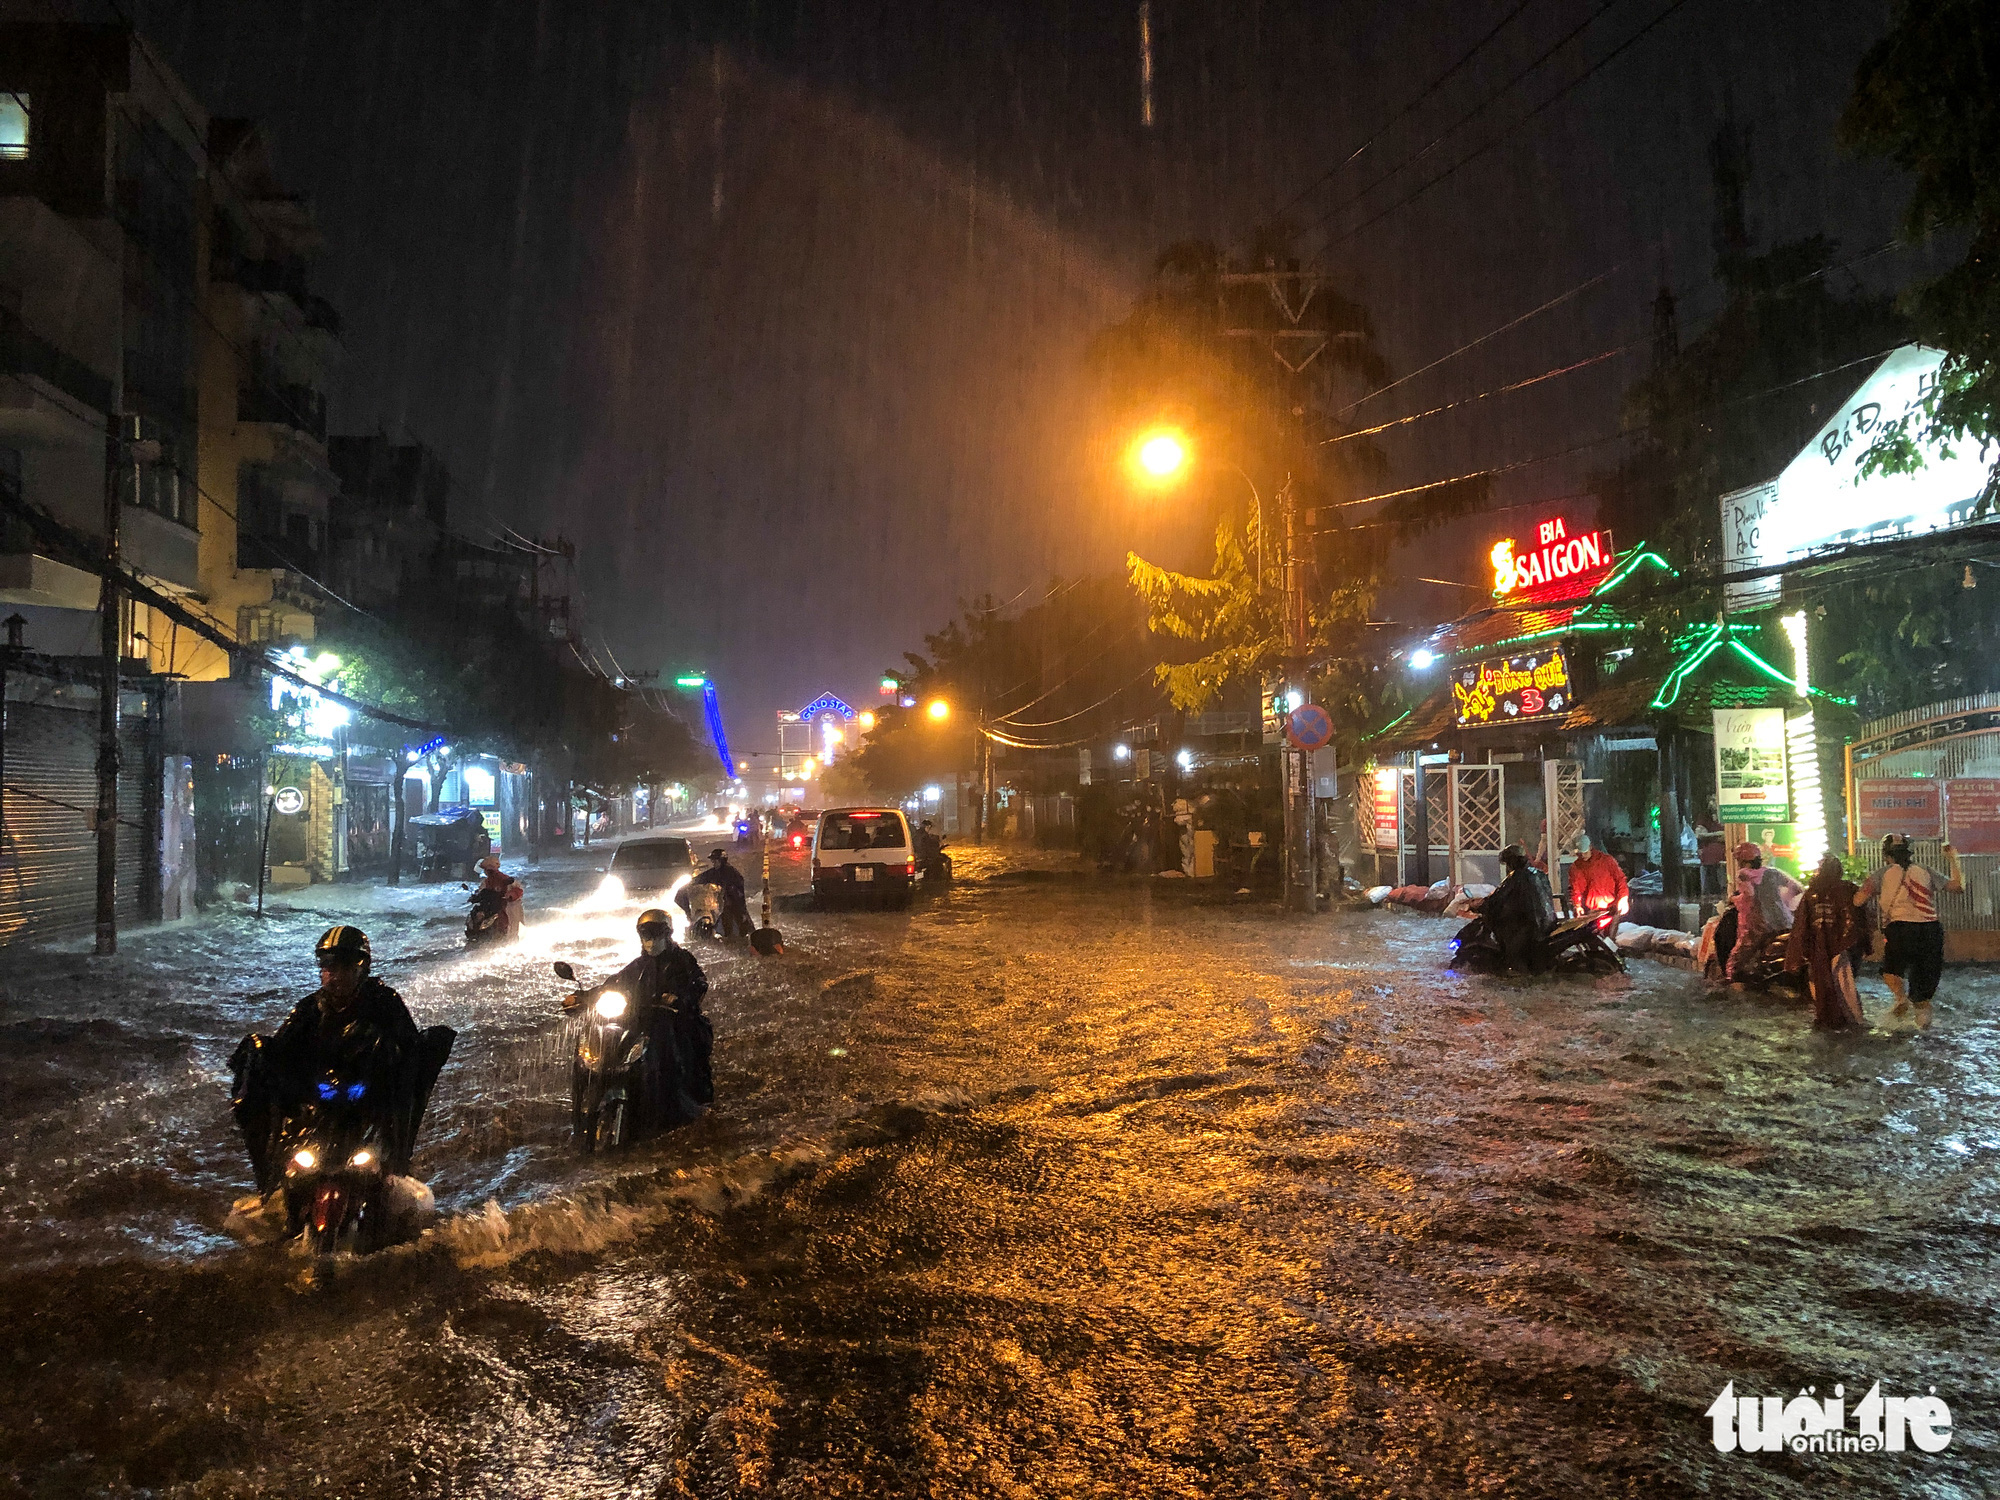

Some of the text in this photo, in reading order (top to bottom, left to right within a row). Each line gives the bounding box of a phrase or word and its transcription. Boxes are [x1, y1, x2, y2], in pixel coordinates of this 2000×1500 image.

[1540, 517, 1566, 545] BIA
[802, 699, 852, 720] GOLD STAR
[1521, 688, 1544, 713] 3
